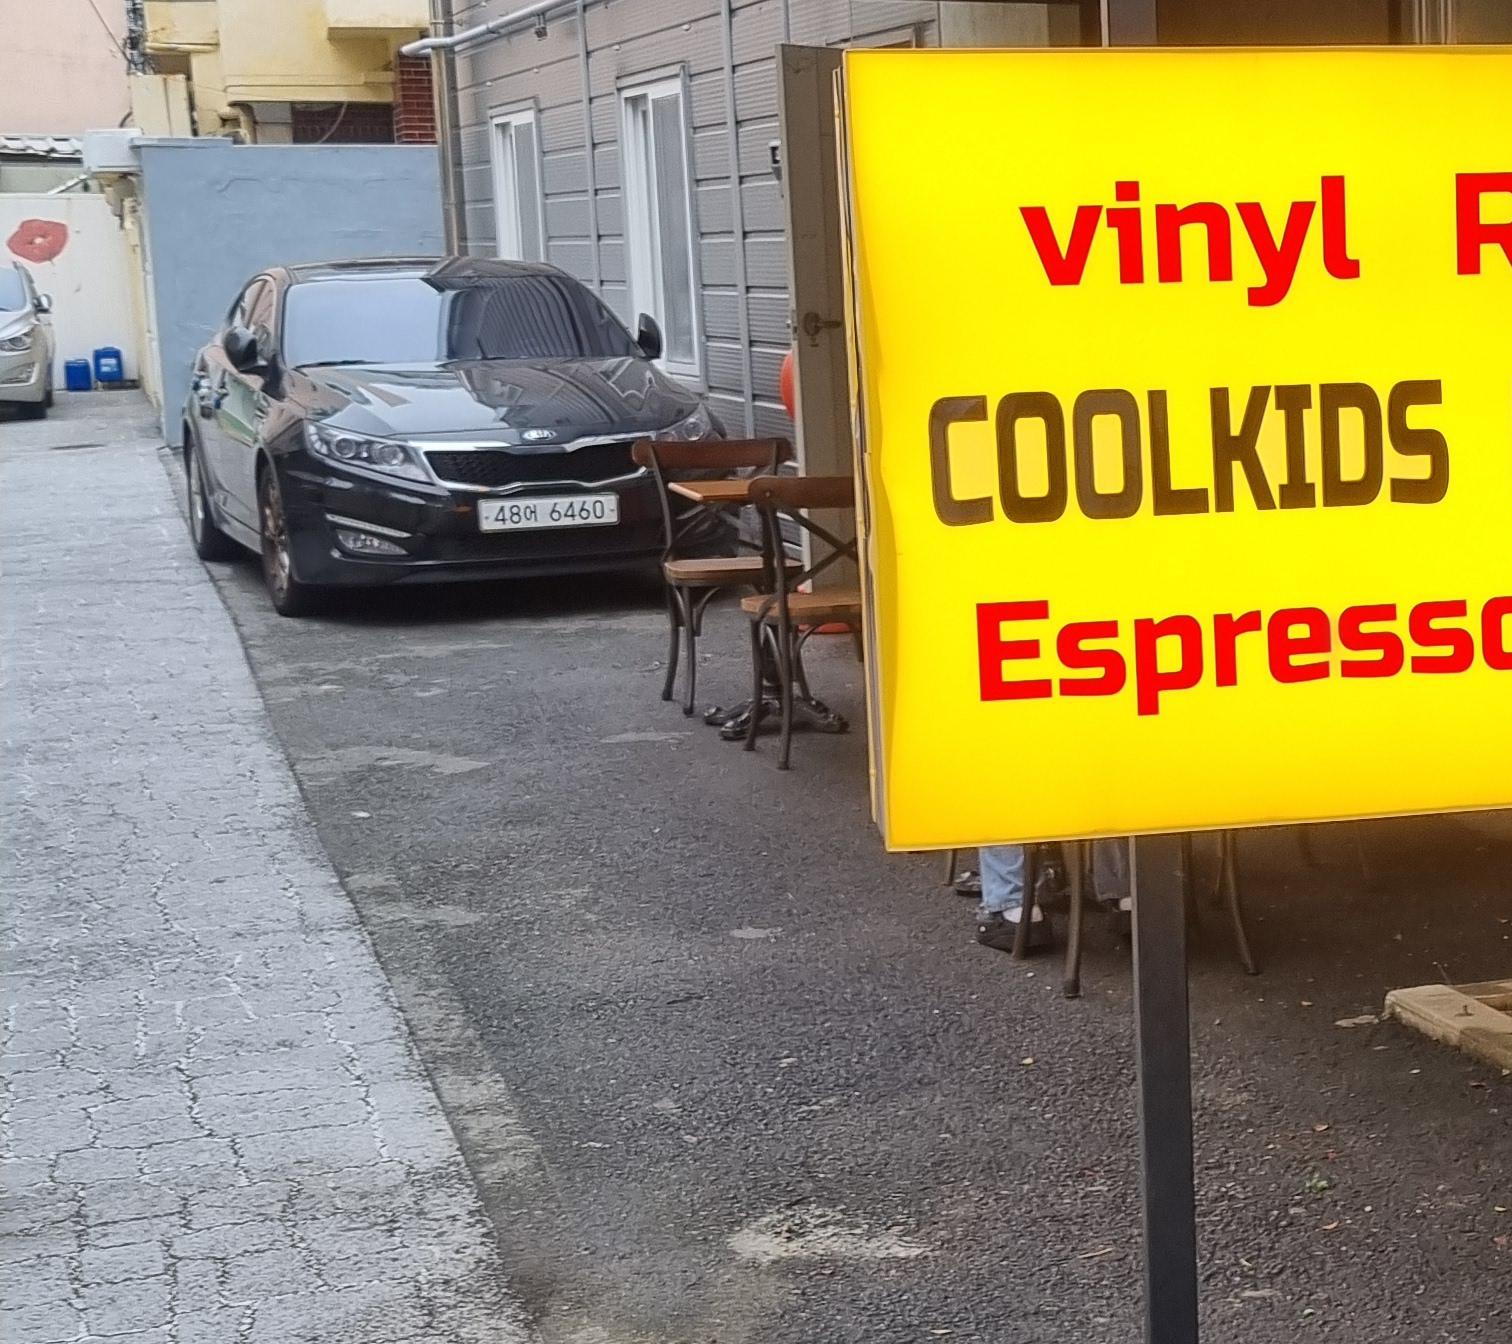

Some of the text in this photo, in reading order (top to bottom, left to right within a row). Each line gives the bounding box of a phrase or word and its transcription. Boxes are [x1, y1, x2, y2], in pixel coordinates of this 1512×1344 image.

[1020, 175, 1360, 307] vinyl
[494, 499, 605, 525] 48어 6460
[927, 378, 1450, 528] COOLKIDS
